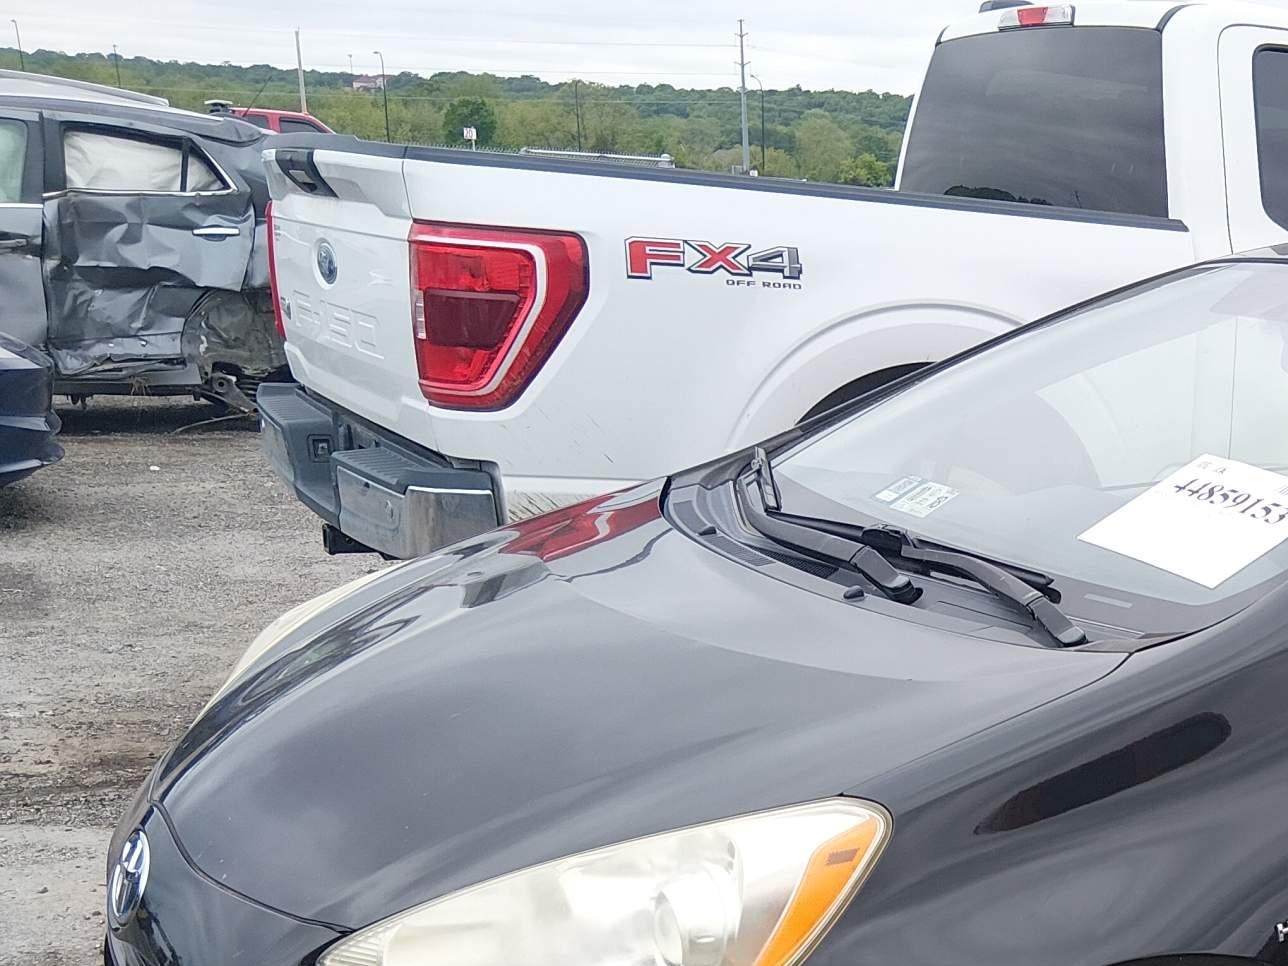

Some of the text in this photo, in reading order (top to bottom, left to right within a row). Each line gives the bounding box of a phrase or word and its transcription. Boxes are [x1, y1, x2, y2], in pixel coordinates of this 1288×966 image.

[624, 236, 802, 280] FX4
[726, 279, 802, 290] OFF ROAD
